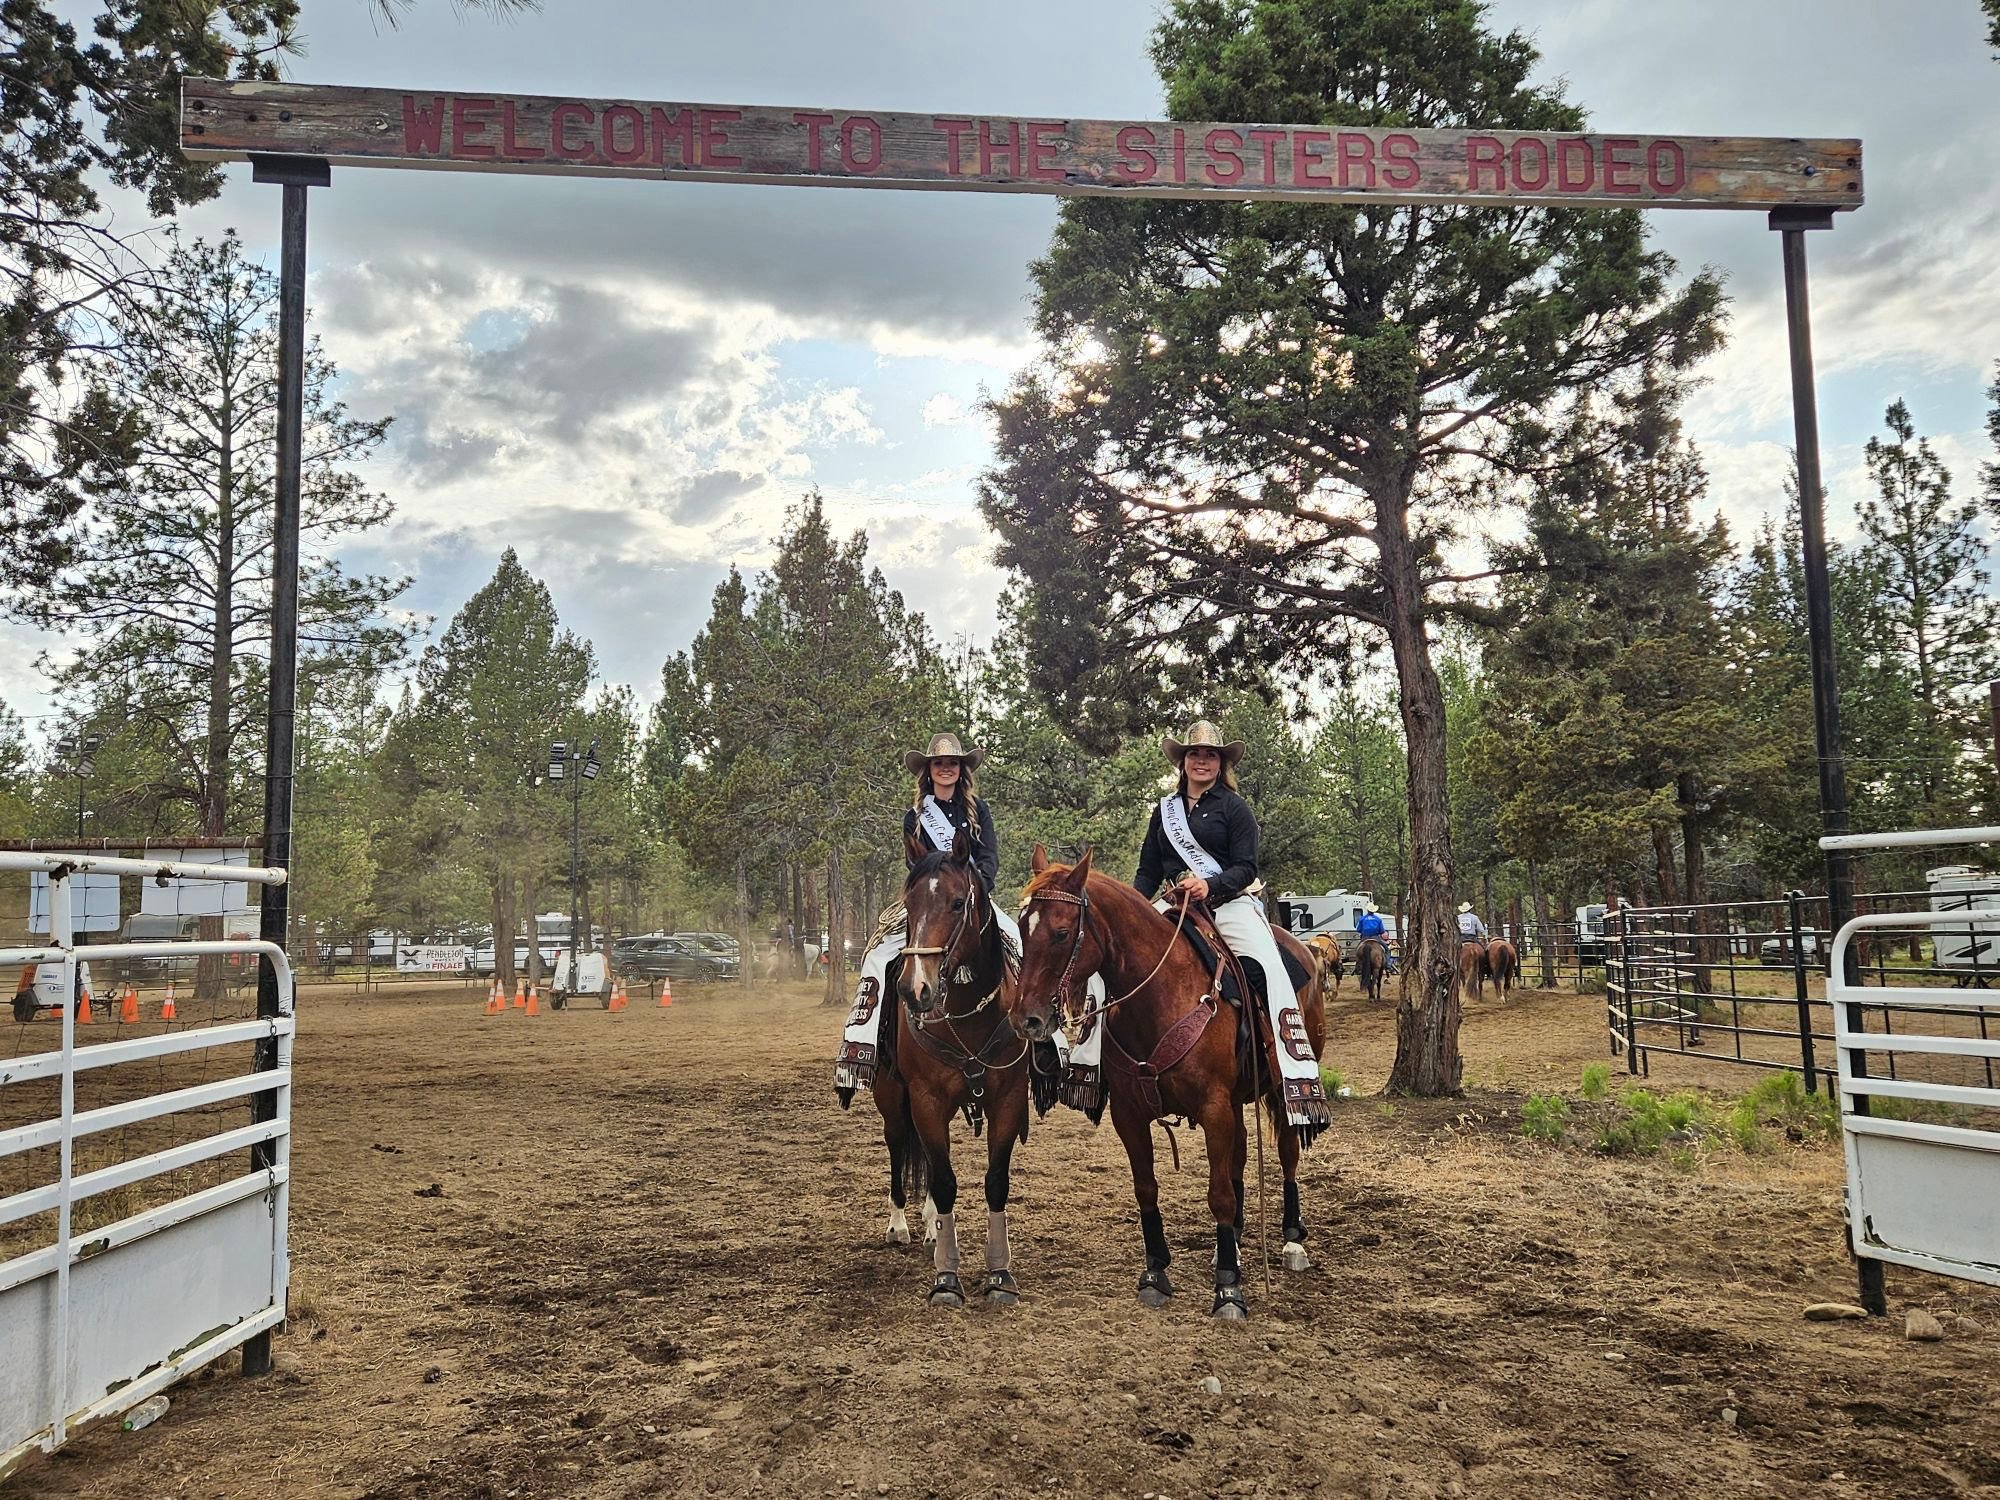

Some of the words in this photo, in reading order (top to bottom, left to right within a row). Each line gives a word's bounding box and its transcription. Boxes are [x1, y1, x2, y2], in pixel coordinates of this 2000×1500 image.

[403, 95, 742, 167] WELCOME
[793, 113, 881, 173] TO
[933, 119, 1066, 180] THE
[1116, 126, 1421, 188] SISTERS
[1466, 136, 1686, 194] RODEO
[431, 962, 463, 970] FINALE
